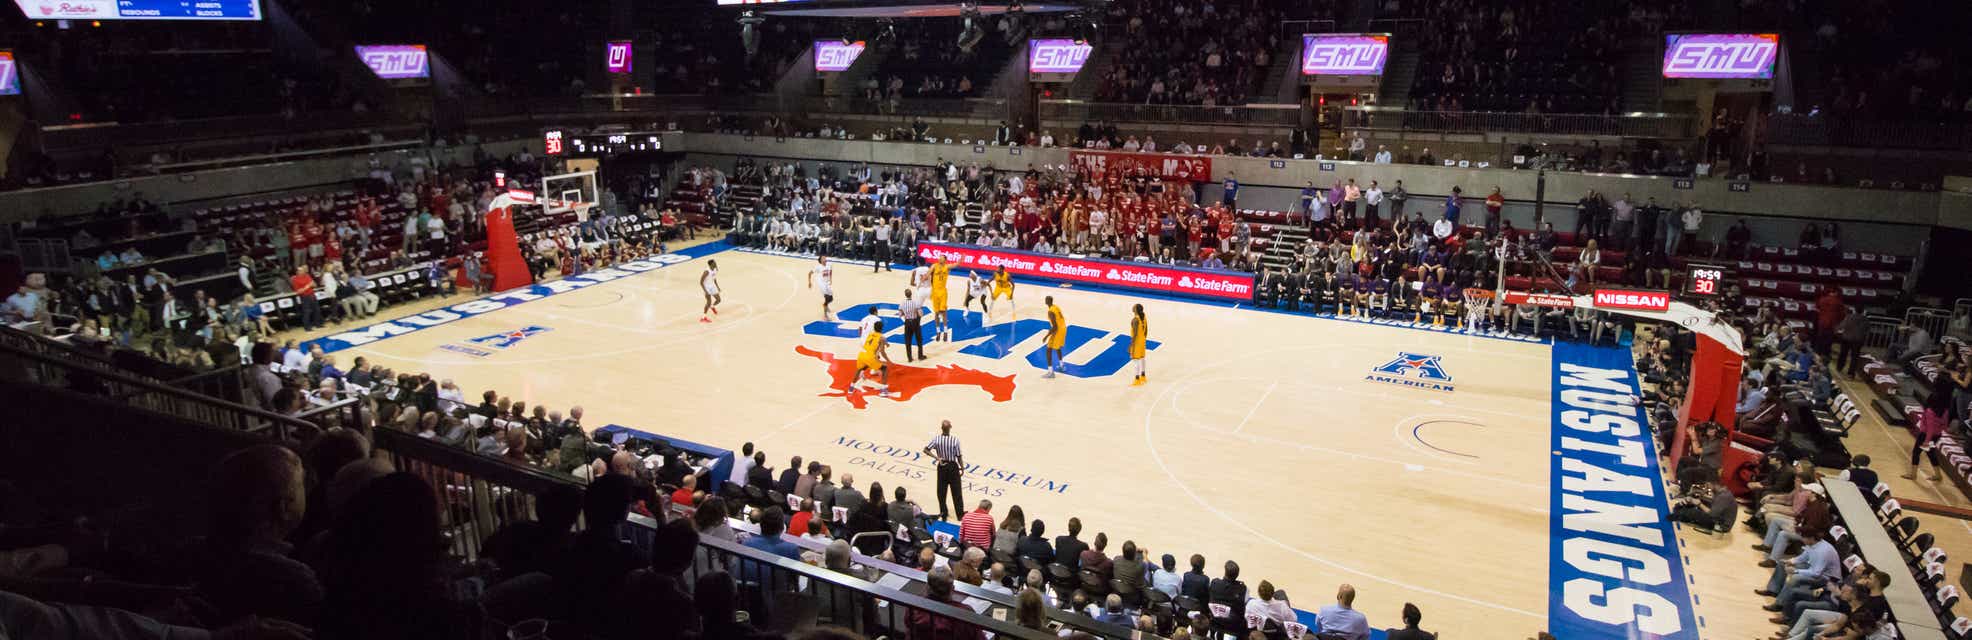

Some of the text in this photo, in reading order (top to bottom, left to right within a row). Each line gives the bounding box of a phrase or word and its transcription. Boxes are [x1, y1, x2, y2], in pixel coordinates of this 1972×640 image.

[363, 50, 424, 74] SMU
[1031, 46, 1093, 69] SMU
[1306, 42, 1387, 71] SMU
[1666, 42, 1775, 73] SMU
[546, 140, 562, 154] 30
[1694, 269, 1721, 280] 19:59
[1695, 280, 1714, 294] 30
[1597, 292, 1666, 307] NISSAN
[801, 302, 1163, 378] SMU
[1365, 375, 1454, 392] AMERICAN
[832, 436, 921, 461] MOODY
[963, 481, 1006, 497] XAS
[1559, 362, 1682, 636] MUSTANGS
